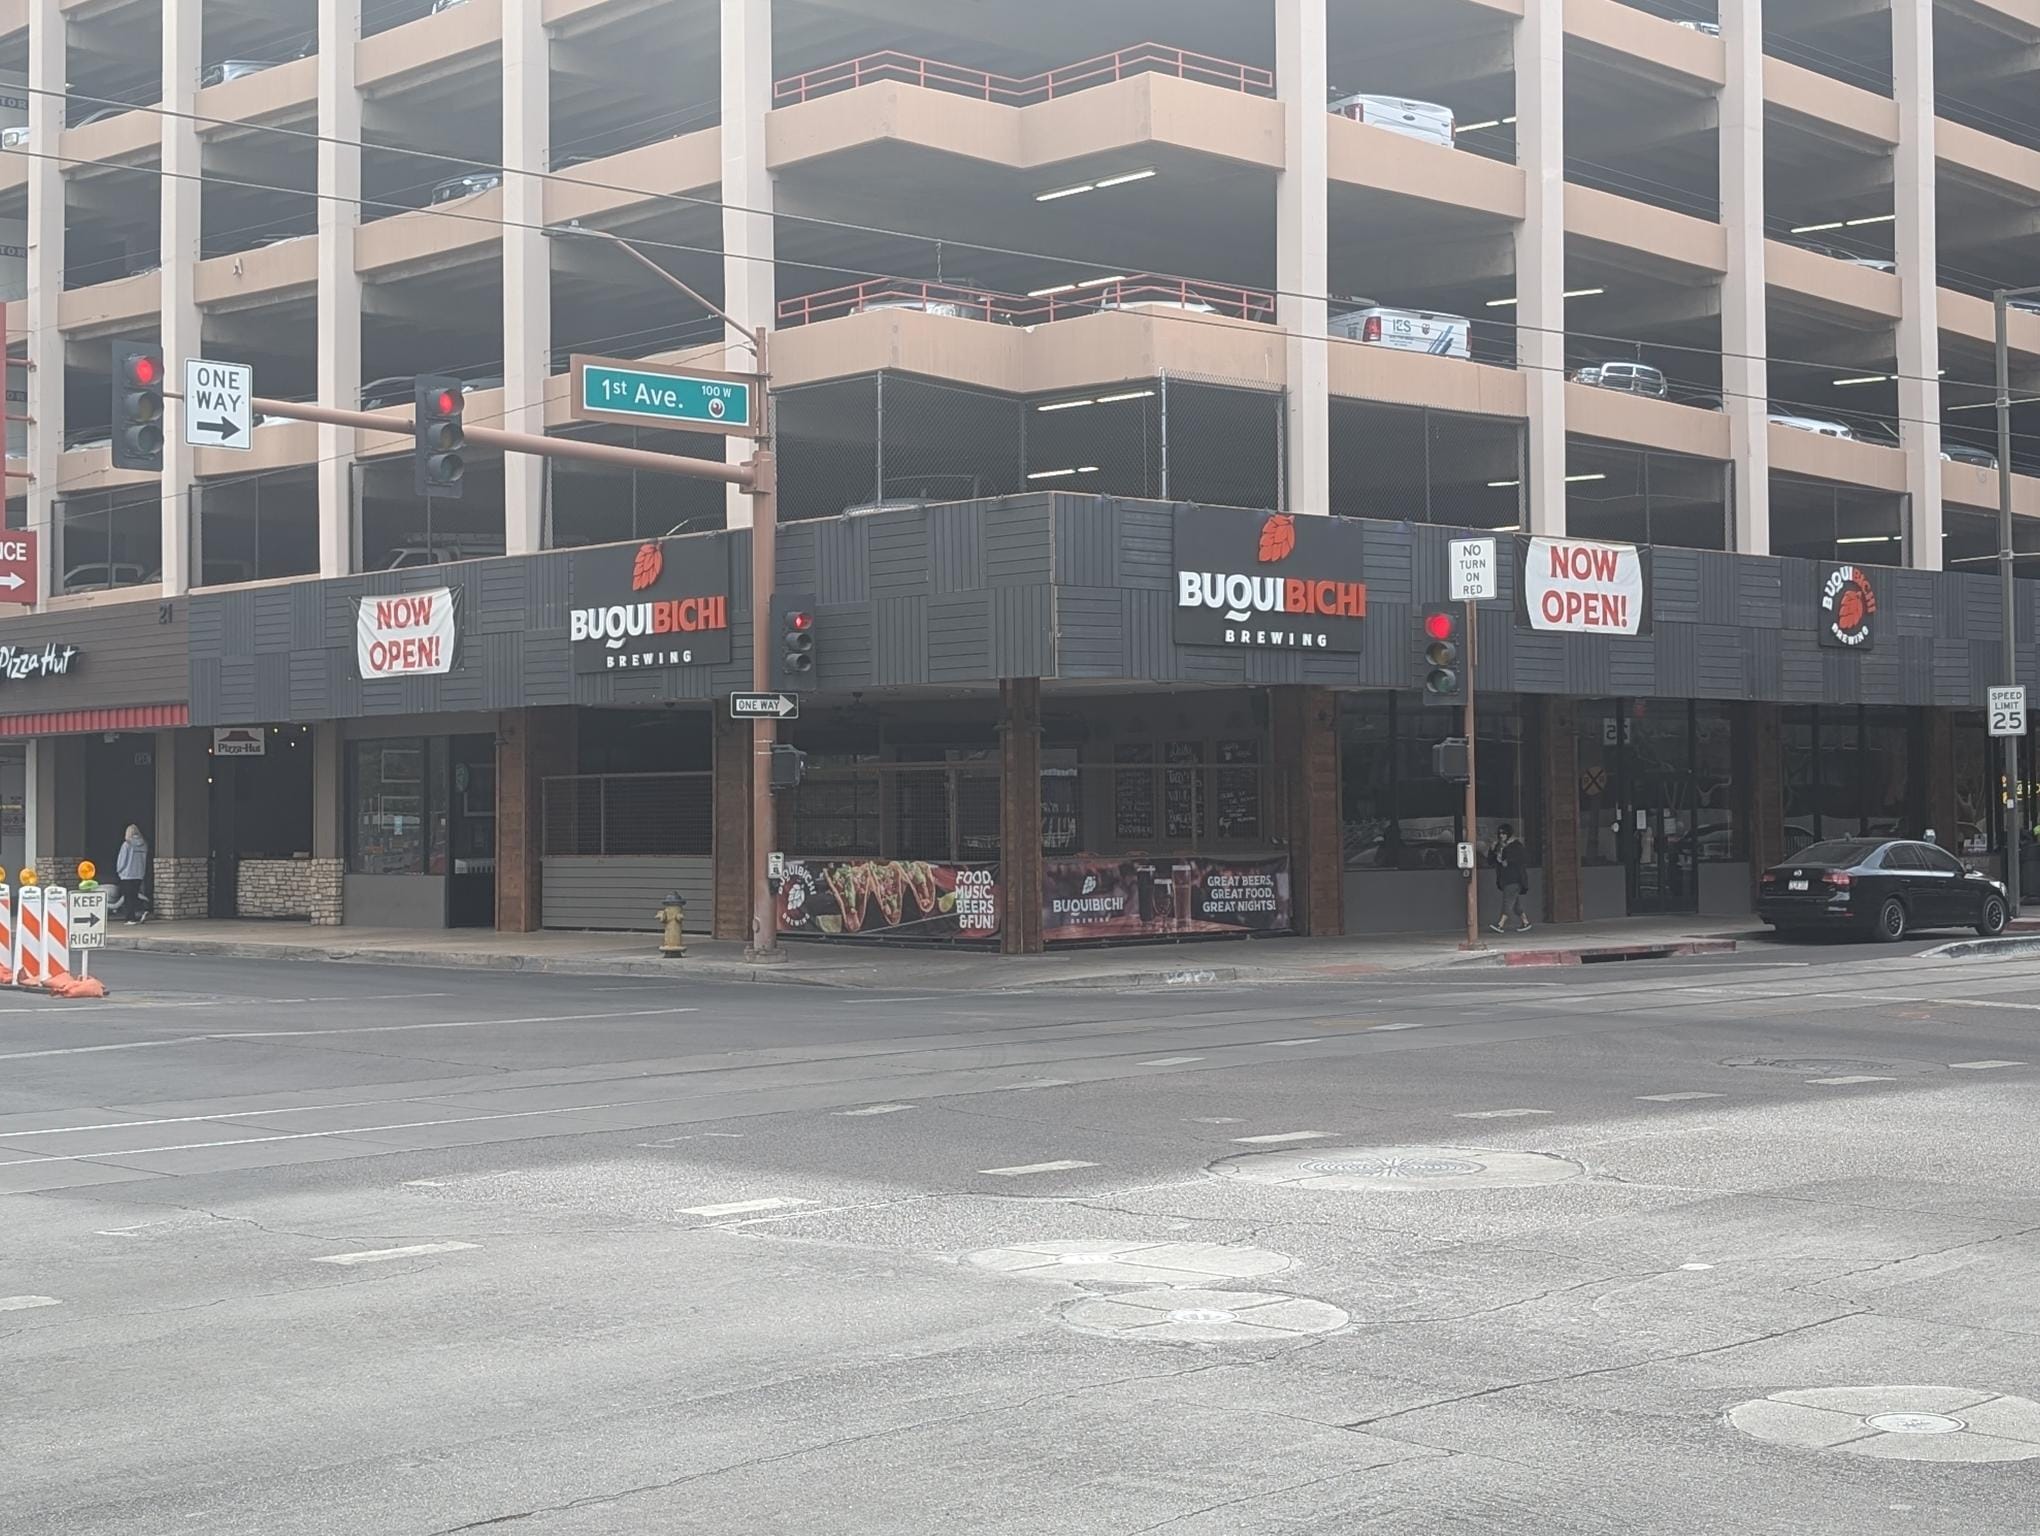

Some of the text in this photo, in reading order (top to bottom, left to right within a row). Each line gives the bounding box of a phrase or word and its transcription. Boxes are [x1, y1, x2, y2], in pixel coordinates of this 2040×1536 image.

[1393, 319, 1411, 332] IES
[198, 368, 240, 390] ONE
[602, 379, 684, 409] 1st Ave.
[702, 385, 732, 398] 100 W
[196, 390, 241, 412] WAY
[1463, 544, 1481, 557] NO
[1459, 560, 1486, 570] TURN
[1550, 545, 1618, 582] NOW
[1466, 572, 1480, 582] ON
[1178, 571, 1366, 622] BUQUIBICHI
[1463, 584, 1483, 595] RED
[1822, 566, 1876, 613] BUQUIBICHI
[159, 604, 173, 624] 21
[376, 596, 432, 630] NOW
[1541, 589, 1628, 628] OPEN!
[570, 596, 727, 649] BUQUIBICHI
[1225, 629, 1327, 648] BREWING
[1832, 622, 1869, 645] BREWING
[41, 642, 76, 677] Hut
[369, 636, 440, 671] OPEN!
[606, 650, 692, 668] BREWING
[1992, 692, 2022, 700] SPEED
[738, 700, 780, 710] ONE WAY
[1995, 702, 2019, 710] LIMIT
[1993, 712, 2022, 730] 25
[955, 871, 994, 886] FOOD,
[1207, 875, 1275, 888] GREAT BEERS,
[955, 885, 994, 900] MUSIC,
[1211, 887, 1275, 899] GREAT FOOD,
[73, 896, 103, 907] KEEP
[955, 900, 994, 914] BEERS
[1053, 897, 1124, 916] BUQUIBICHI
[1202, 900, 1277, 912] GREAT NIGHTS!
[959, 914, 994, 929] &FUN!
[70, 933, 104, 945] RIGHT
